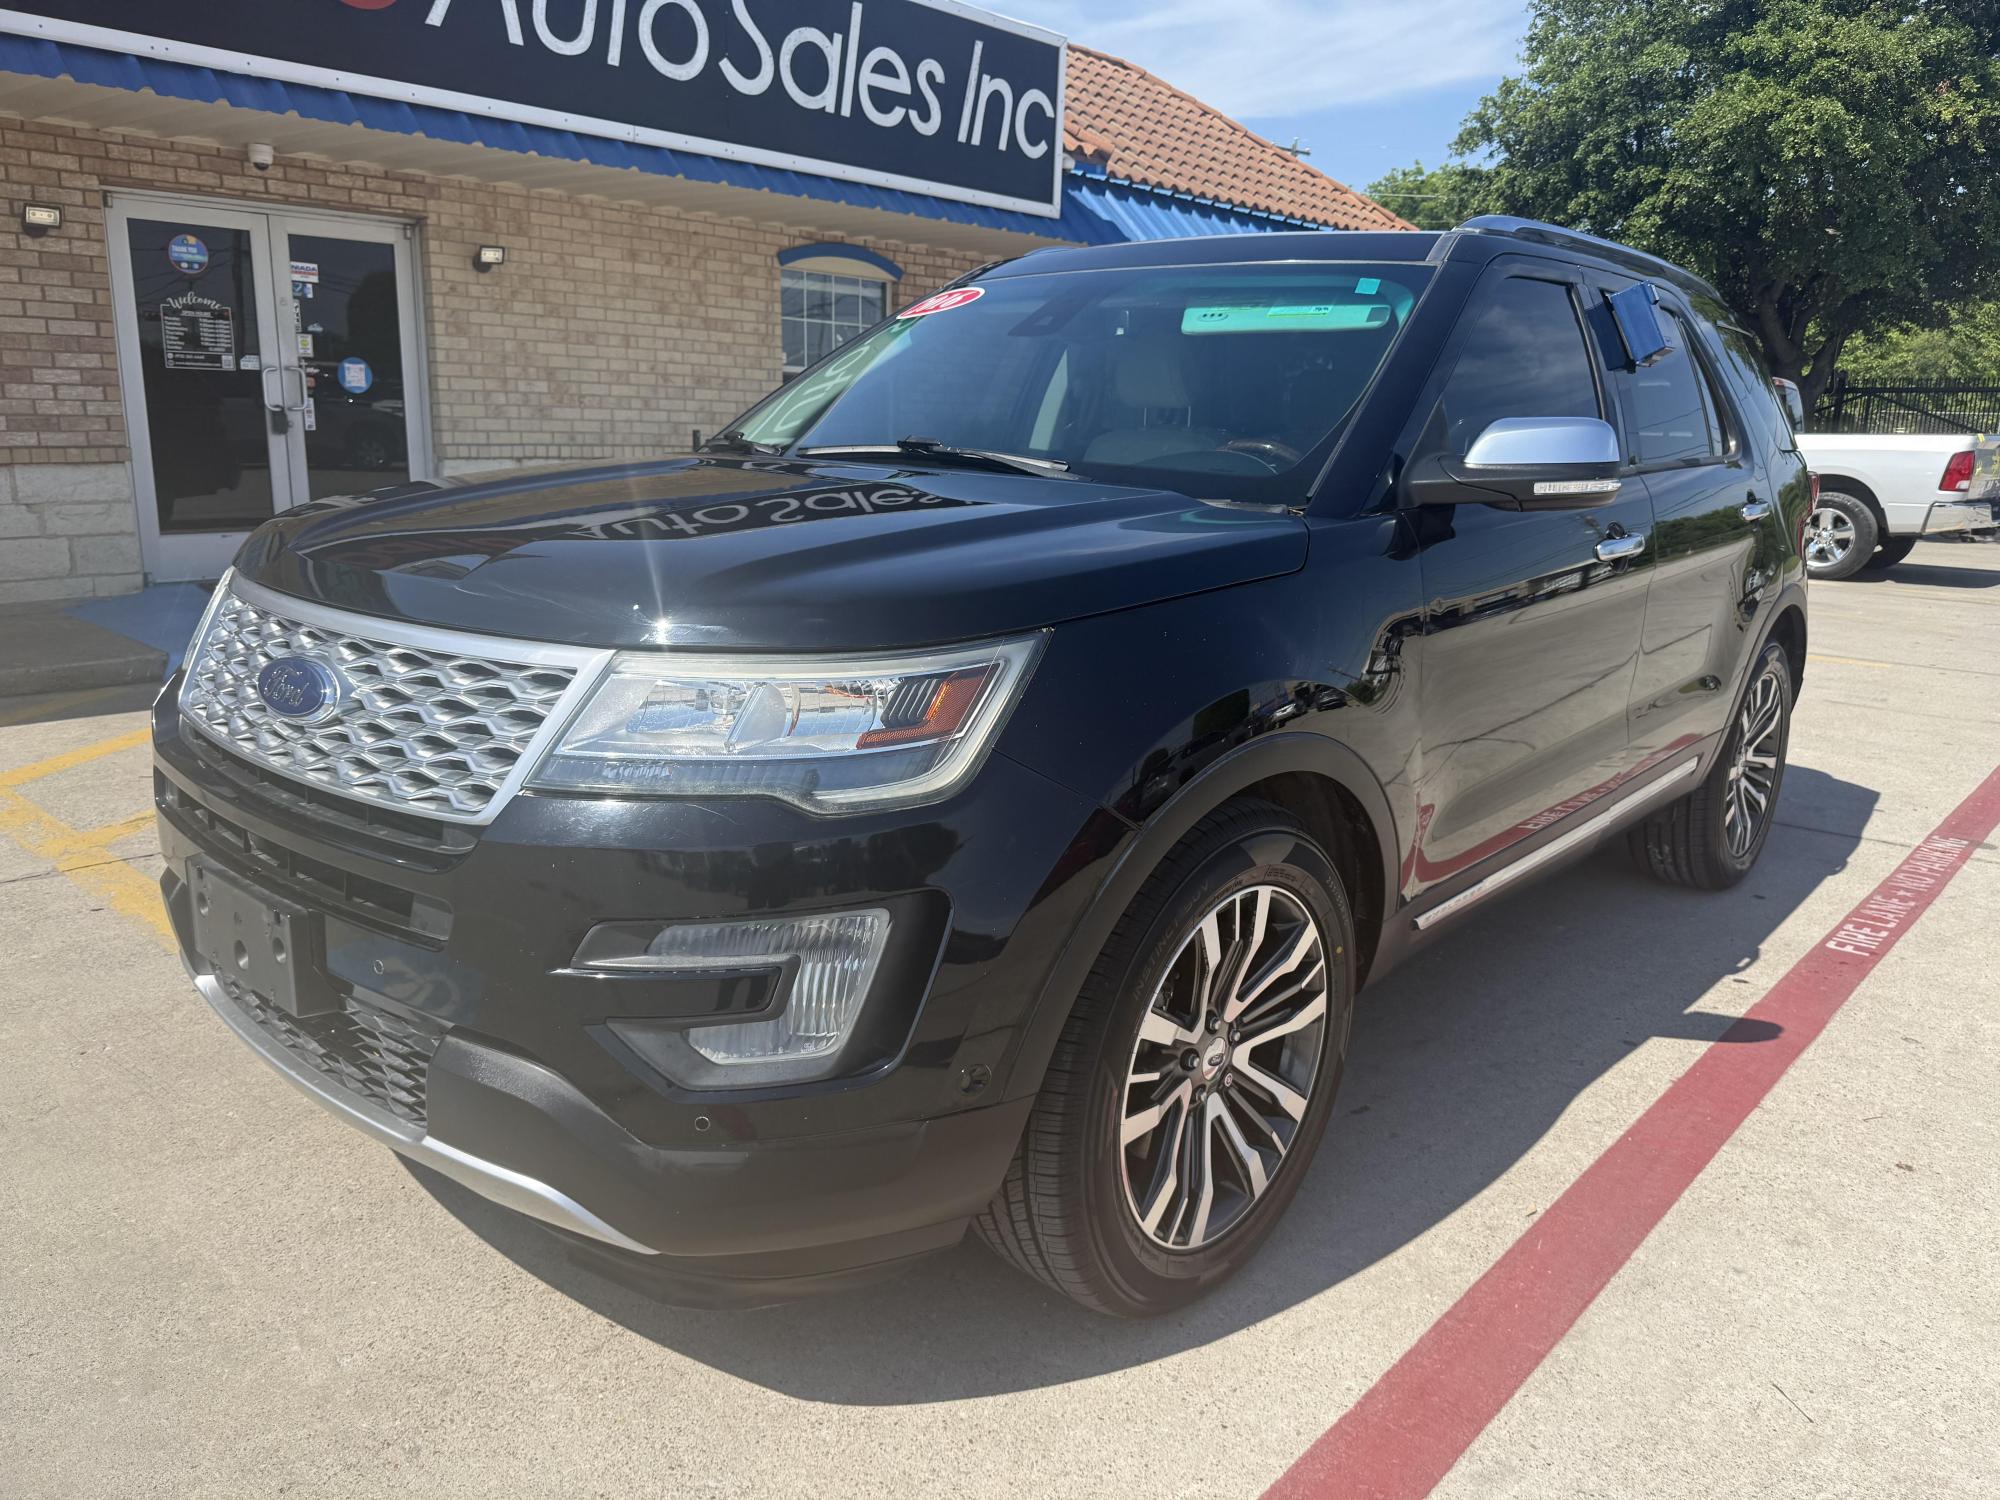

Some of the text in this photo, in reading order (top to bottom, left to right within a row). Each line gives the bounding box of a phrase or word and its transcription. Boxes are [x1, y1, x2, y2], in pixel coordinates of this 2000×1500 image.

[958, 40, 1054, 160] Inc
[166, 291, 222, 310] Welcome
[263, 665, 310, 707] Ford
[1825, 835, 1970, 957] FIRE LANE NO PARKING
